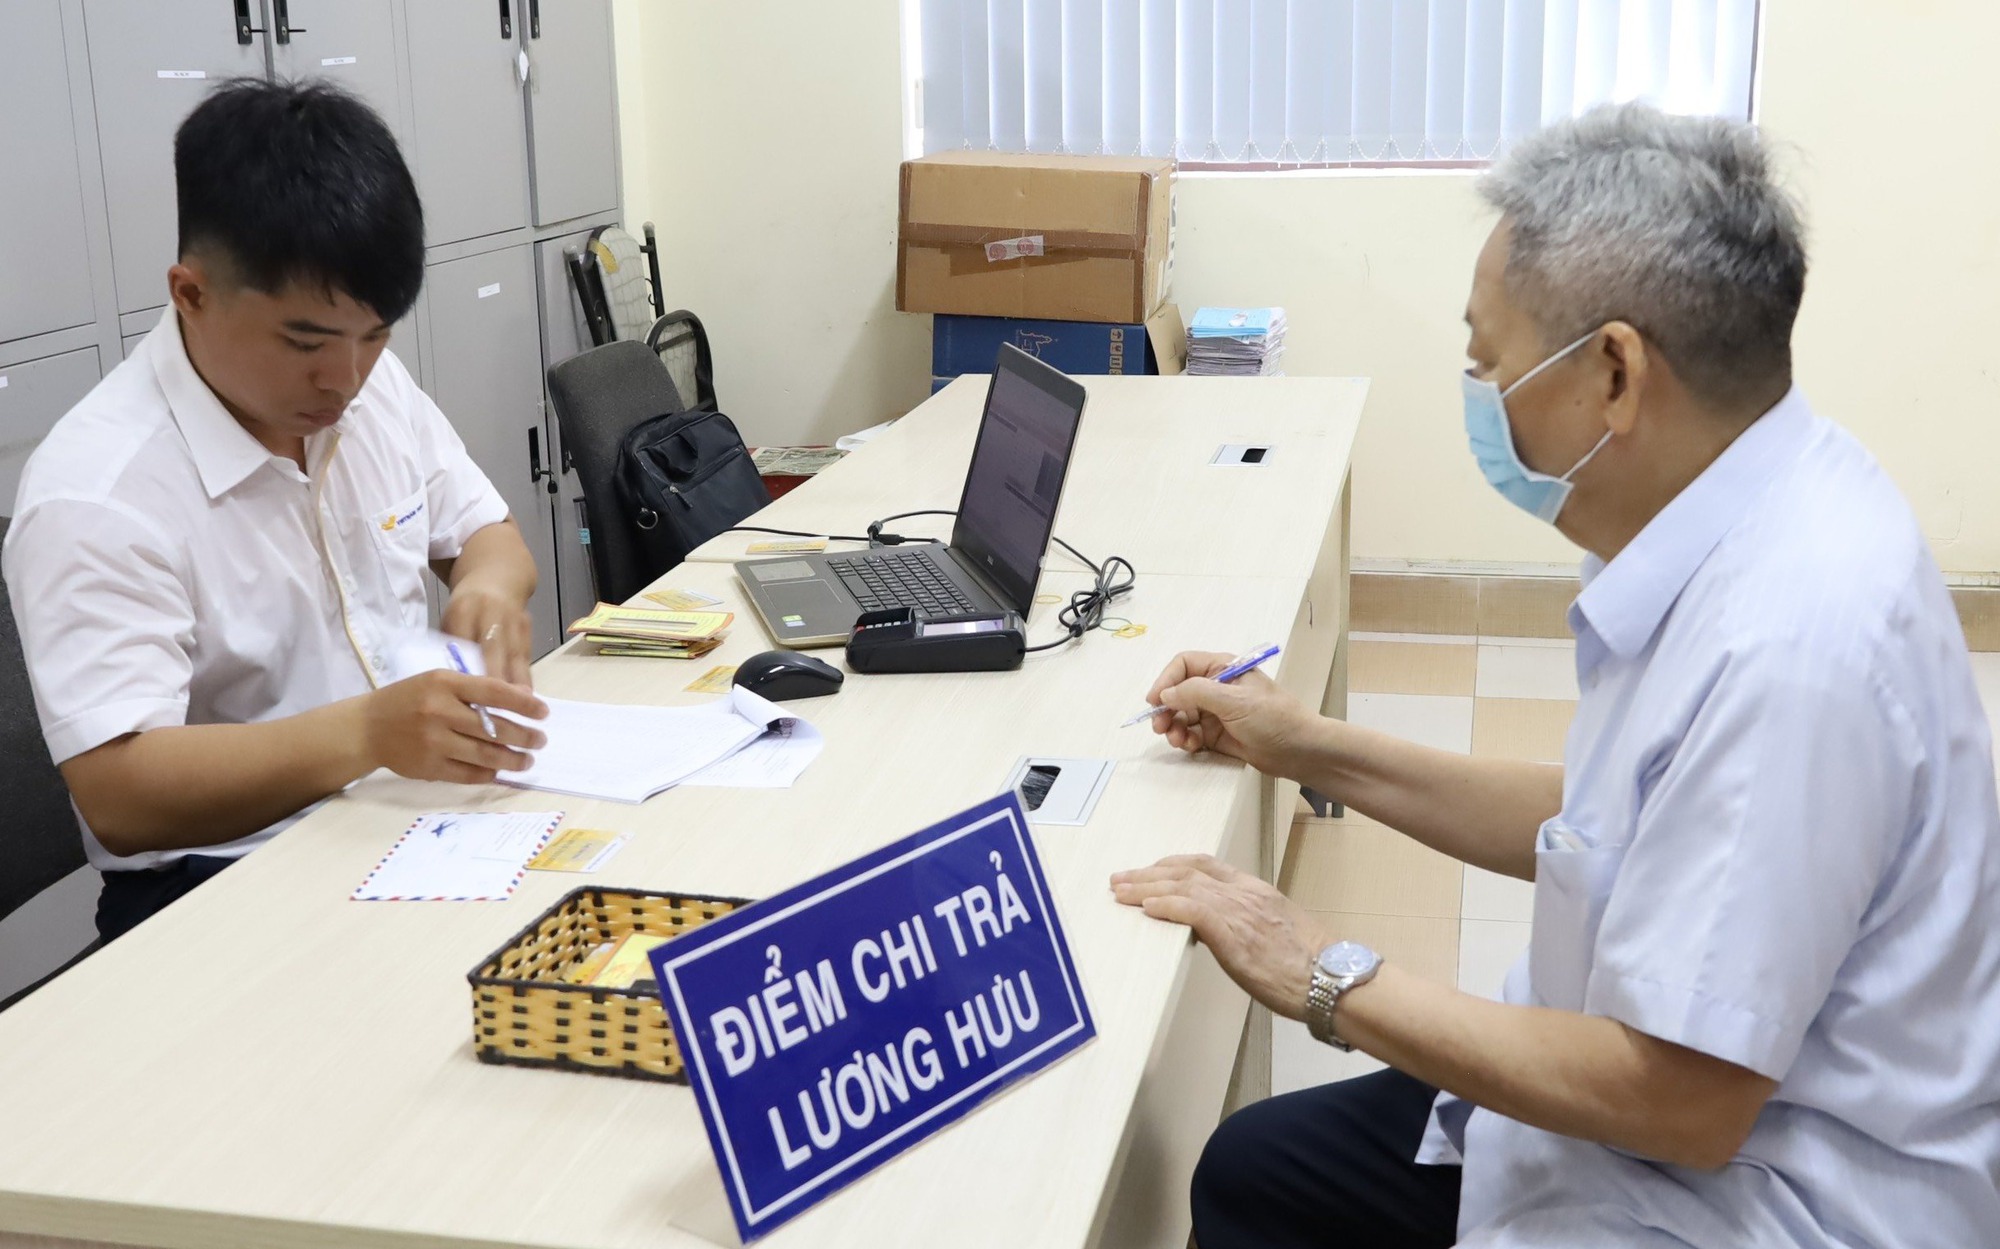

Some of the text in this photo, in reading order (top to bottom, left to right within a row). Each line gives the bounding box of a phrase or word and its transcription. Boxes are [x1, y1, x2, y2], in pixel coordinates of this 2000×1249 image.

[710, 850, 1032, 1077] ĐIỂM CHI TRẢ
[768, 969, 1041, 1170] LƯƠNG HƯU
